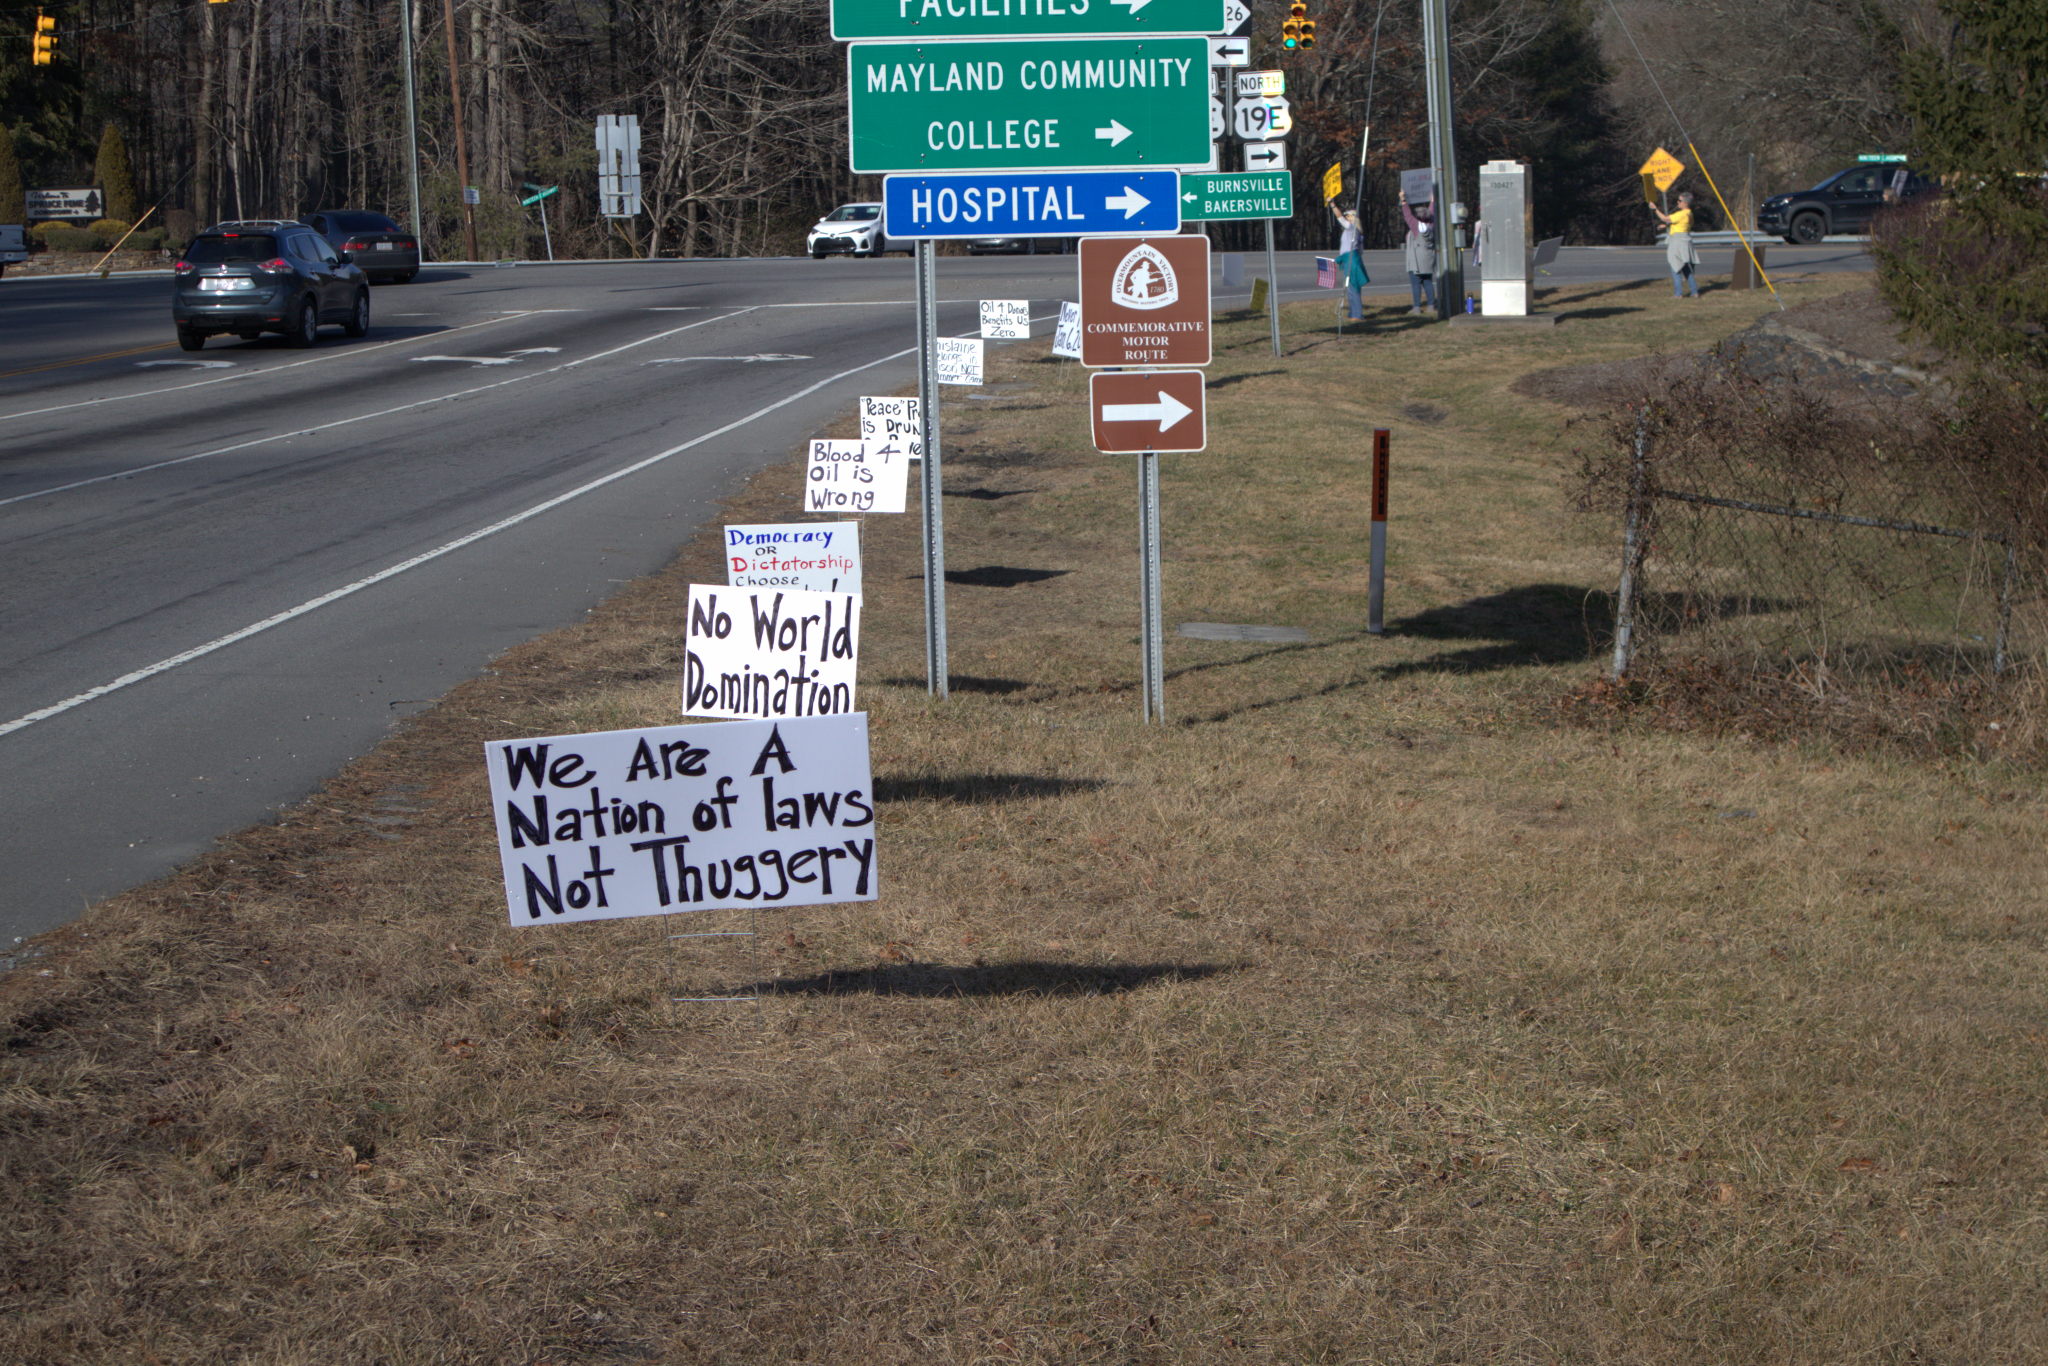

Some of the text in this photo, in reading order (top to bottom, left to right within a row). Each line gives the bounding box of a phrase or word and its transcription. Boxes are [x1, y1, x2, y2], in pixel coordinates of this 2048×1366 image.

[1226, 6, 1243, 21] 26
[867, 58, 1192, 93] MAYLAND COMMUNITY
[1240, 76, 1281, 91] NORTH
[1241, 105, 1285, 132] 19E
[927, 119, 1060, 150] COLLEGE
[1207, 178, 1284, 193] BURNSVILLE
[912, 186, 1085, 223] HOSPITAL
[1204, 197, 1288, 213] BAKERSVILLE
[1116, 250, 1175, 293] OVERMOUNTAIN VICTORY
[980, 301, 994, 313] Oil
[990, 326, 1016, 338] Zero
[1087, 321, 1204, 333] COMMEMORATIVE
[937, 340, 976, 353] islaine
[1122, 336, 1169, 346] MOTOR
[937, 352, 962, 365] elongs
[1125, 350, 1168, 360] ROUTE
[938, 363, 957, 373] ison
[862, 417, 876, 433] is
[814, 441, 865, 463] Blood
[875, 443, 902, 464] 4
[809, 463, 874, 483] Oil is
[810, 487, 875, 511] Wrong
[728, 529, 833, 549] Democracy
[755, 545, 777, 556] OR
[730, 554, 853, 575] Dictatorship
[691, 592, 853, 662] No World
[686, 649, 850, 718] Domination
[502, 722, 798, 791] We Are A
[507, 776, 874, 849] Nation of laws
[522, 845, 615, 919] Not
